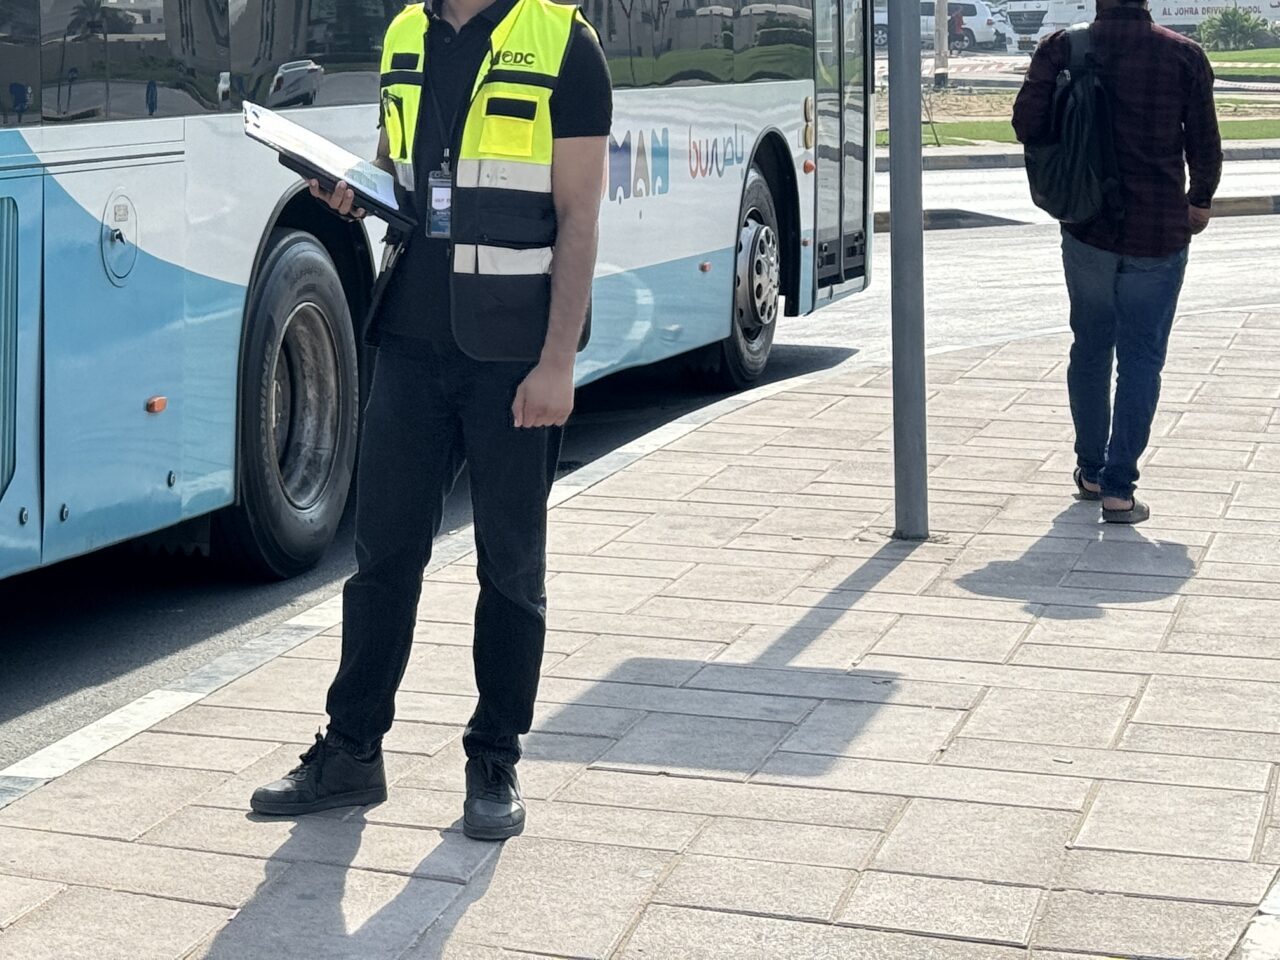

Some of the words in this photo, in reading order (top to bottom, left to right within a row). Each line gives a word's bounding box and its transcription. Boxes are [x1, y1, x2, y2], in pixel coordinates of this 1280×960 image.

[1163, 7, 1172, 16] AL
[1175, 7, 1199, 16] JOHRA
[602, 127, 669, 205] MAN
